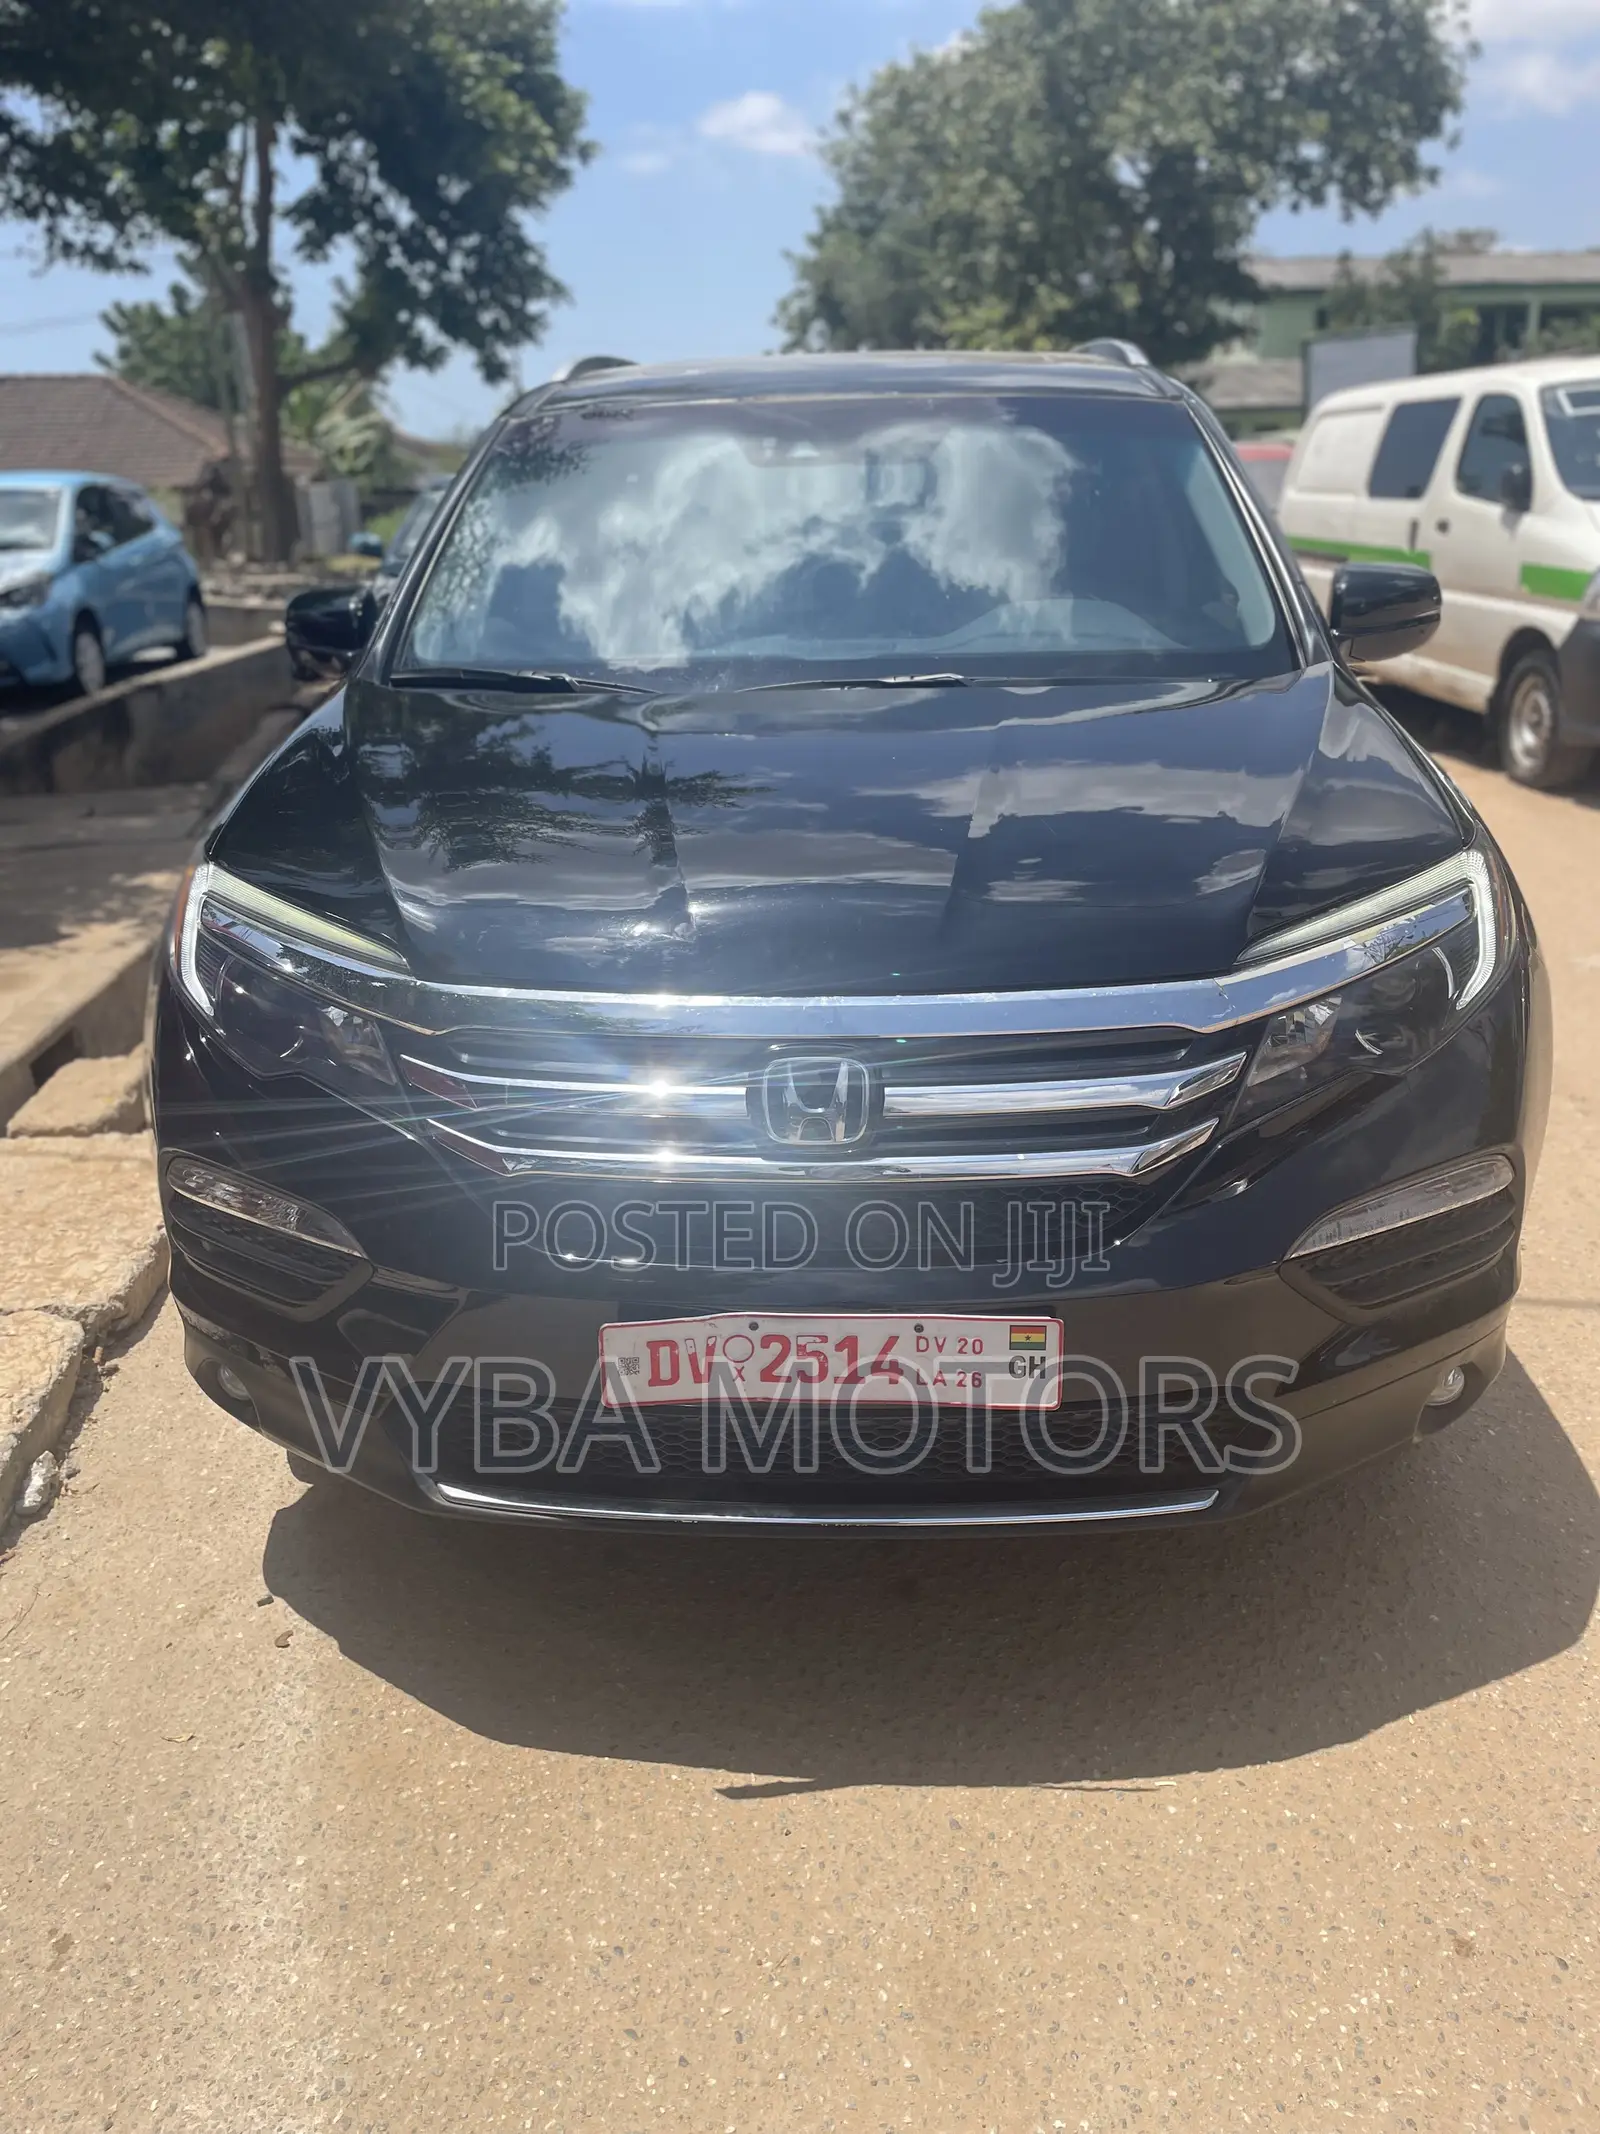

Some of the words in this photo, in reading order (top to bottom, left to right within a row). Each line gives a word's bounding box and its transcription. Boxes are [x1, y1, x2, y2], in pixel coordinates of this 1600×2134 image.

[916, 1335, 947, 1354] DV
[957, 1337, 984, 1356] 20
[647, 1335, 718, 1387] DV
[759, 1333, 905, 1386] 2514
[1008, 1355, 1047, 1380] GH
[916, 1368, 948, 1387] LA
[956, 1370, 983, 1389] 26
